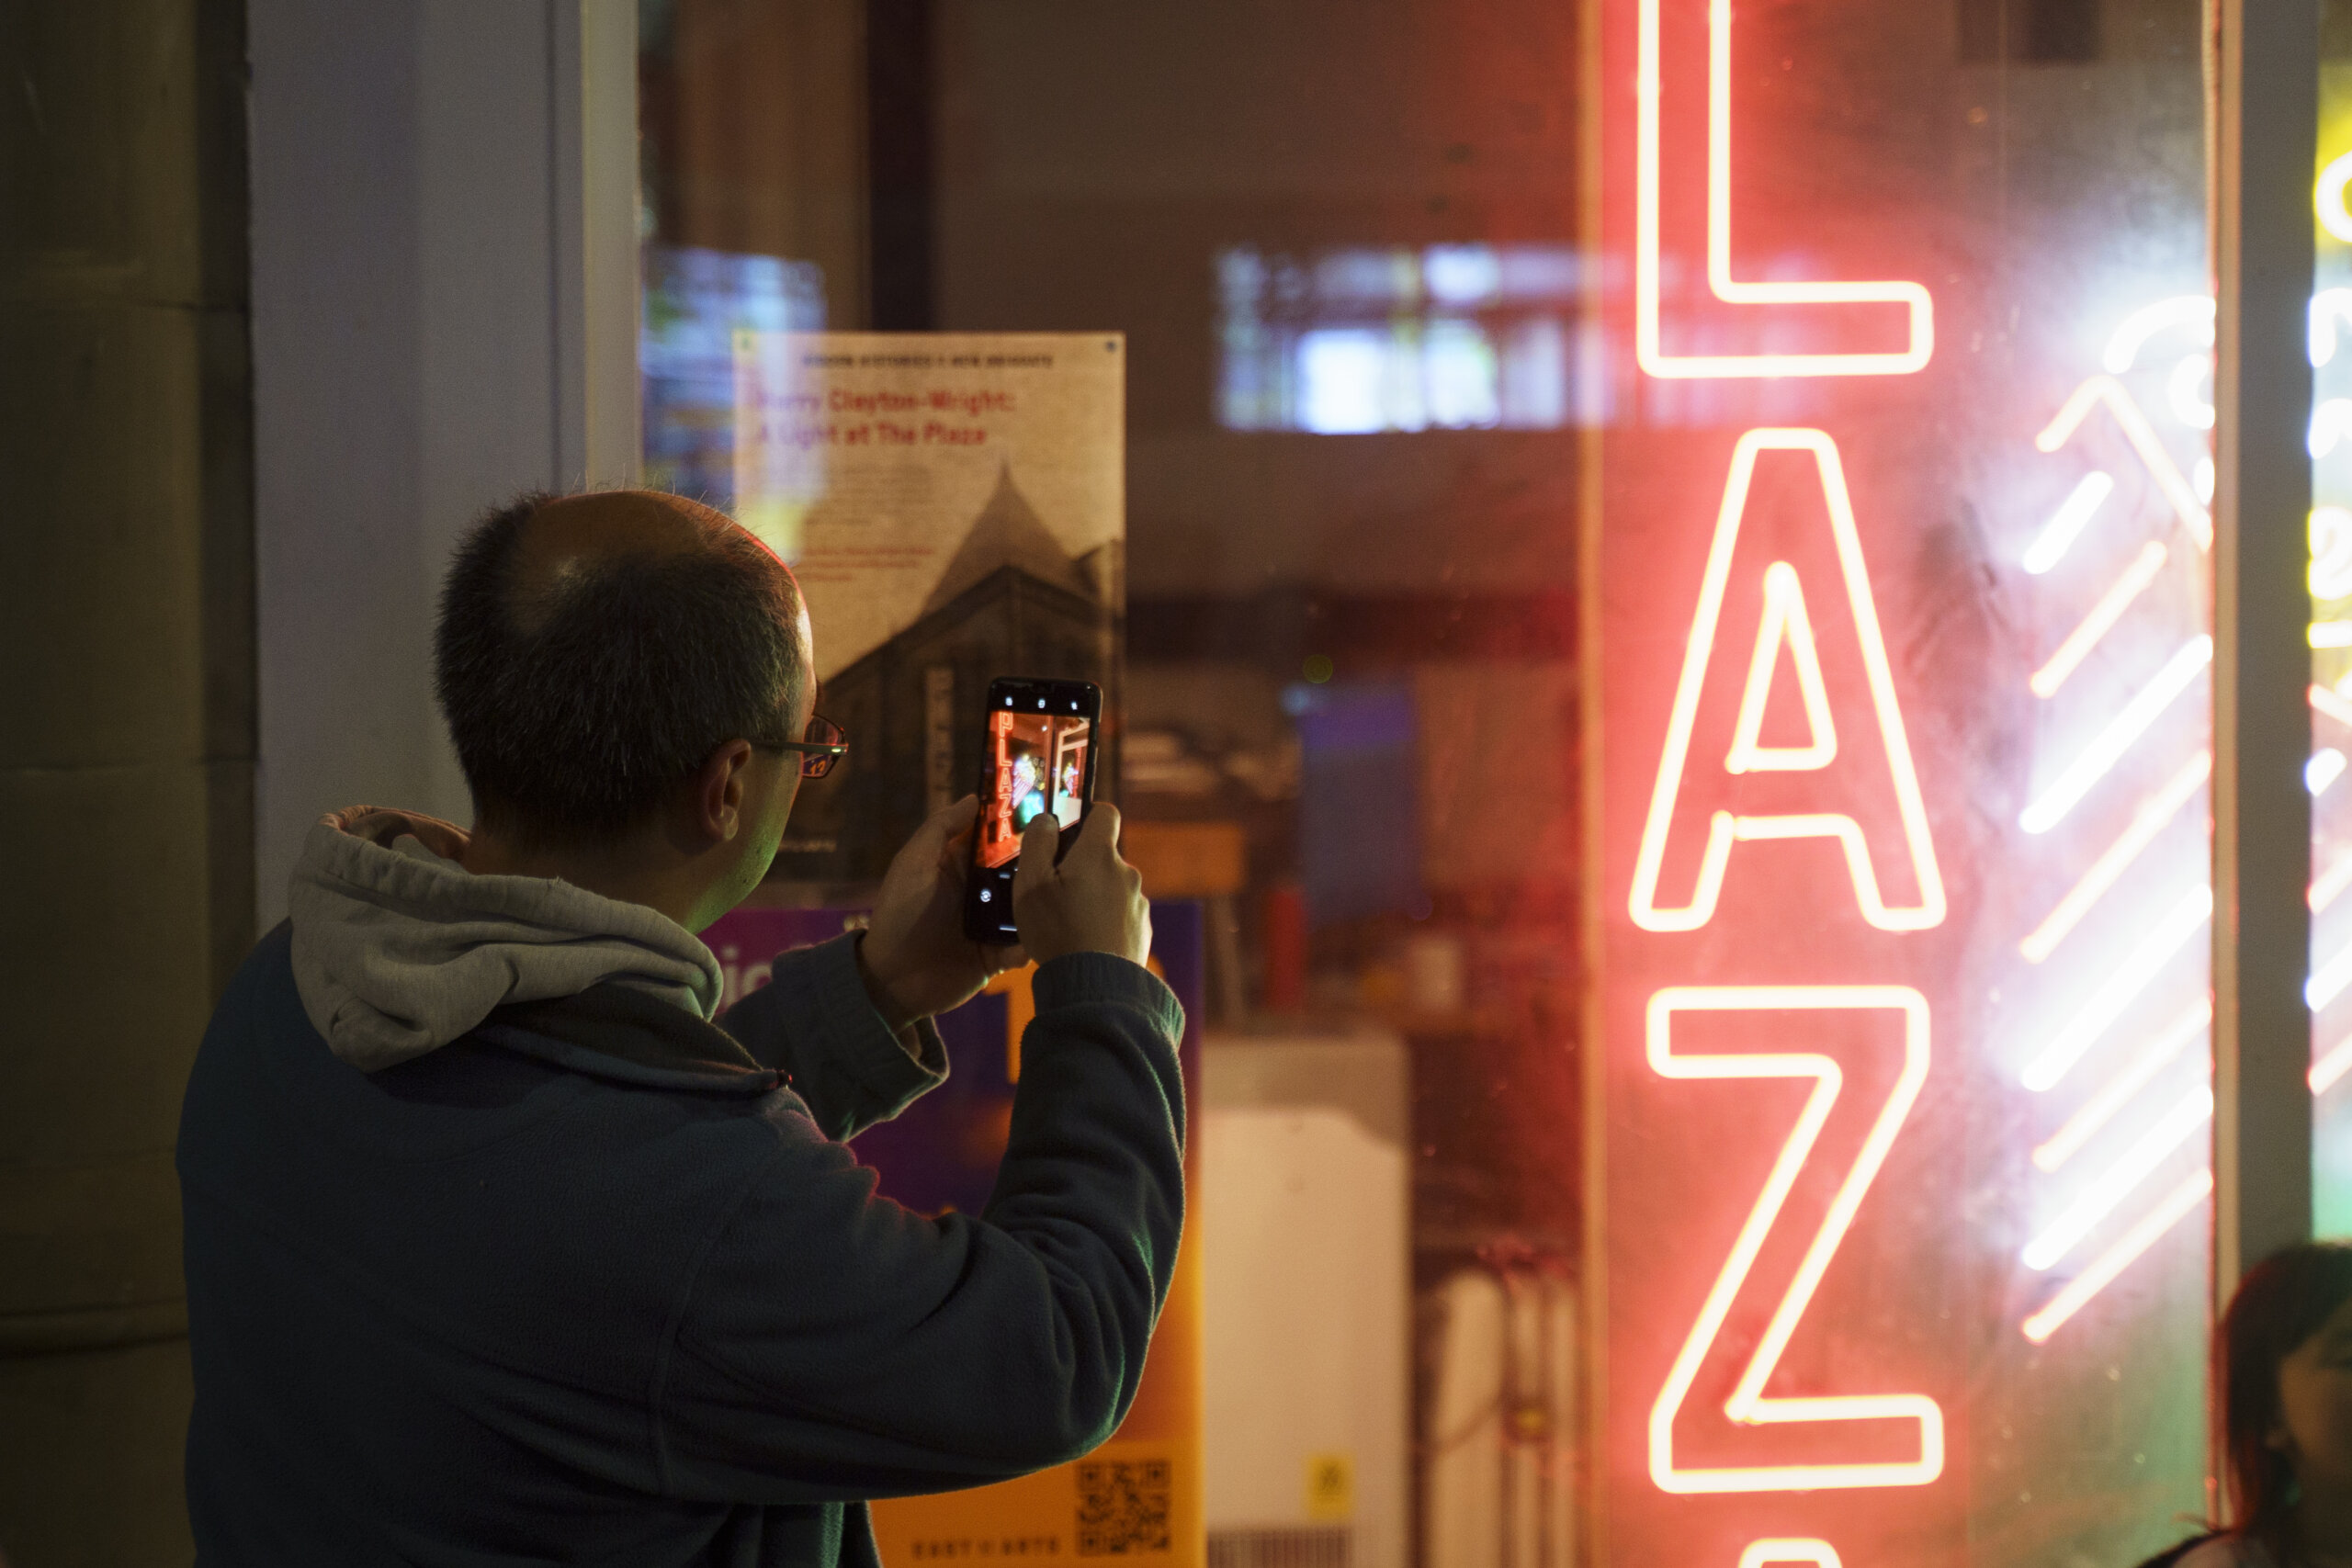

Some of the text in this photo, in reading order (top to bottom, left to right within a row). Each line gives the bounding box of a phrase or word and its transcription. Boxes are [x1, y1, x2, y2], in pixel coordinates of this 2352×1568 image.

[845, 423, 871, 446] at
[877, 422, 917, 446] The
[922, 421, 988, 446] Plaza
[998, 711, 1014, 842] PLAZA
[1629, 0, 1947, 1568] LAZ
